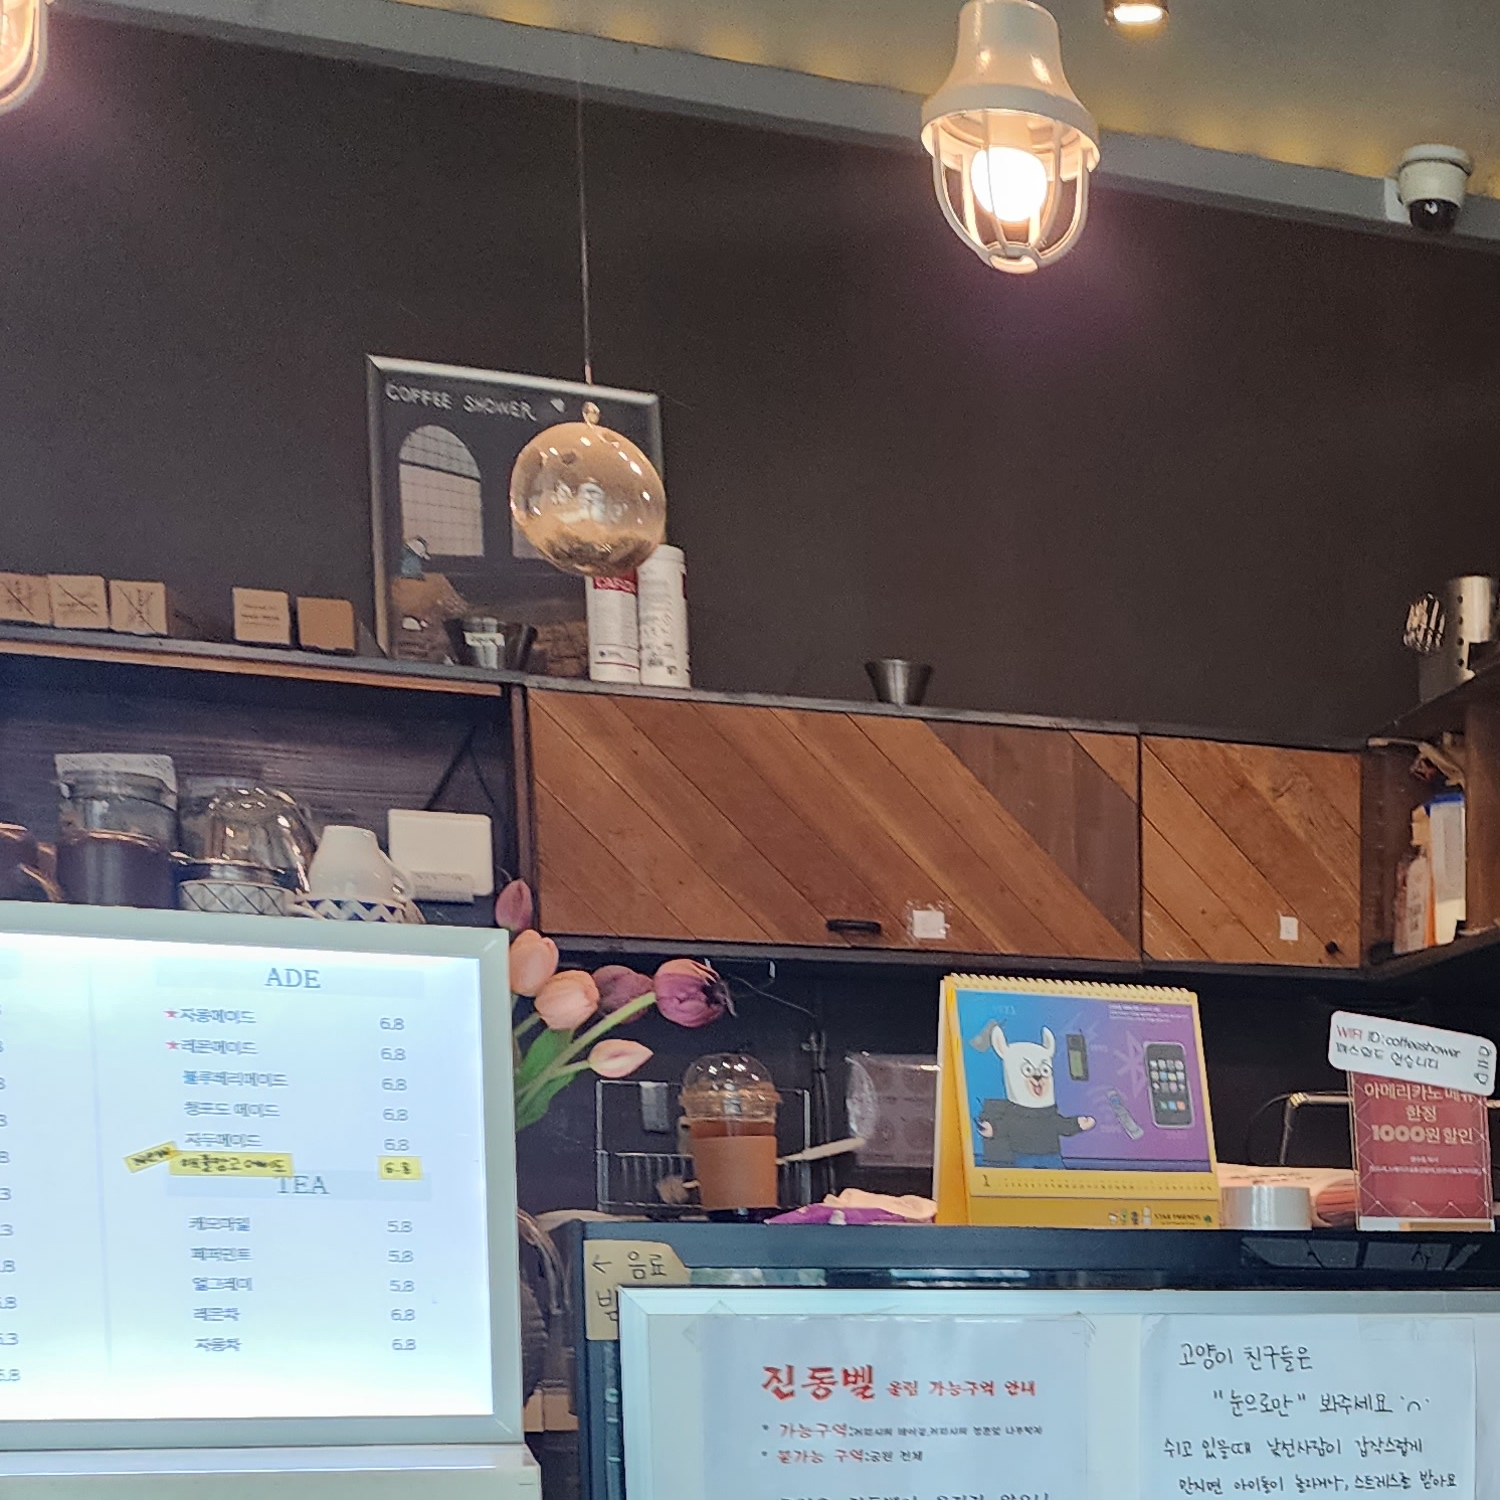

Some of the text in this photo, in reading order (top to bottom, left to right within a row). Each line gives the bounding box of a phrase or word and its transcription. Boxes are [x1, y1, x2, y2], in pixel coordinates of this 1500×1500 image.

[384, 383, 537, 422] COFFEE SHOWER
[264, 967, 322, 989] ADE
[379, 1017, 405, 1031] 6.8
[380, 1047, 407, 1061] 6.8
[1335, 1041, 1439, 1069] 패스워드 없습니다
[381, 1078, 408, 1091] 6.8
[1364, 1083, 1443, 1101] 아메리카노
[382, 1108, 409, 1122] 6.8
[1406, 1105, 1437, 1122] 한정
[1372, 1125, 1474, 1145] 1000원 할인
[383, 1138, 410, 1151] 6.8
[277, 1175, 331, 1195] TEA
[387, 1220, 413, 1233] 5.8
[388, 1250, 414, 1263] 5.8
[627, 1250, 667, 1280] 음료
[389, 1280, 415, 1293] 5.8
[391, 1309, 415, 1321] 6.8
[392, 1339, 416, 1351] 6.8
[1178, 1342, 1313, 1372] 고양이 친구들은
[761, 1364, 1036, 1400] 진동벨 울림 가능구역 안내
[1319, 1392, 1393, 1415] 봐주세요
[777, 1449, 824, 1464] 불가능
[900, 1449, 924, 1462] 전체
[1163, 1438, 1194, 1458] 쉬고
[1201, 1437, 1251, 1460] 있을때
[1178, 1476, 1224, 1496] 만지면
[1233, 1475, 1284, 1494] 아이들이
[1418, 1468, 1457, 1489] 받아요
